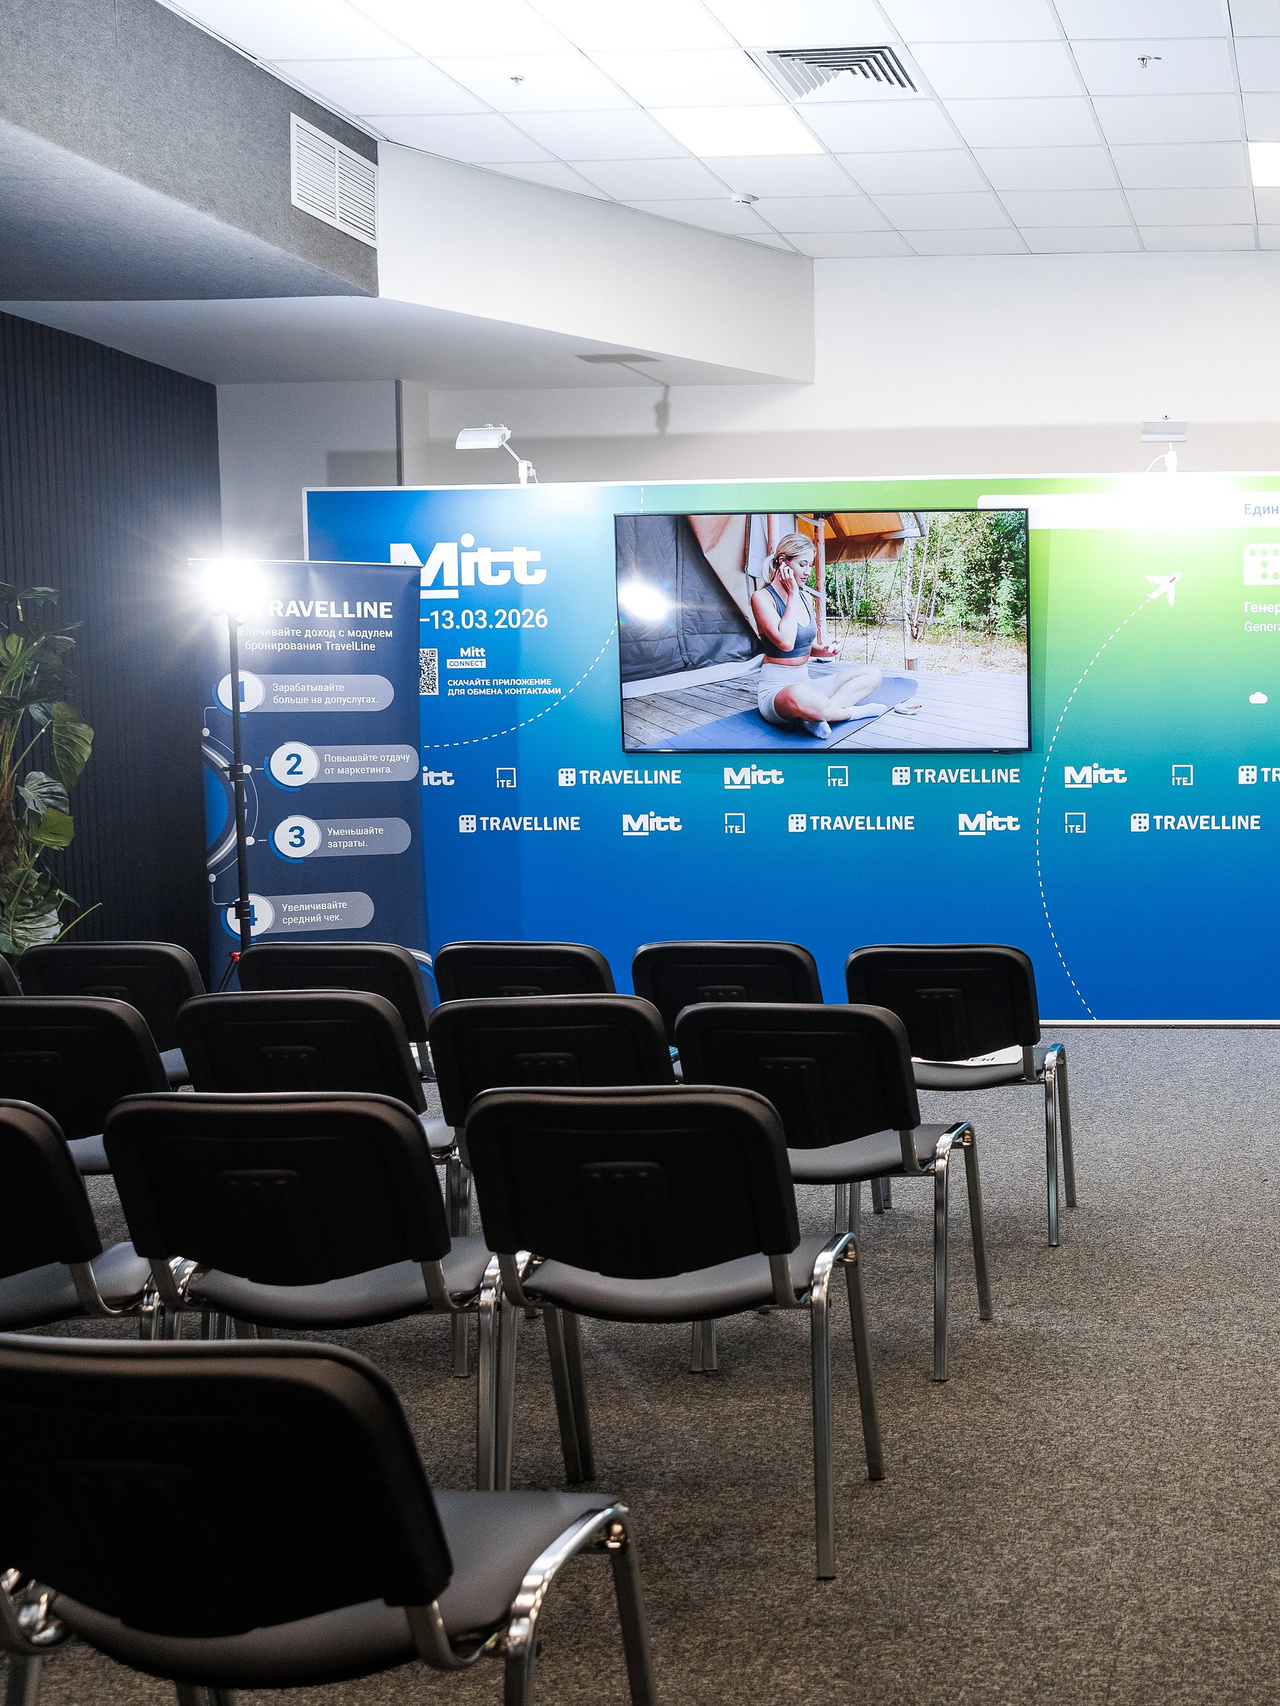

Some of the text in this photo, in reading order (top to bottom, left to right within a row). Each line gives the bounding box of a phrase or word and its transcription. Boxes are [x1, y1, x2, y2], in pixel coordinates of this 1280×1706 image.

[390, 533, 547, 587] Mitt
[239, 627, 393, 639] еличивайте доход с модулем
[245, 640, 376, 652] бронирования TravelLine
[460, 646, 486, 657] Mitt
[272, 682, 344, 693] Зарабатывайте
[447, 678, 552, 686] СКАЧАЙТЕ ПРИЛОЖЕНИЕ
[447, 688, 465, 696] ДЛЯ
[504, 687, 561, 695] КОНТАКТАМИ
[273, 695, 310, 704] больше
[324, 696, 379, 706] допуслугах.
[285, 753, 303, 775] 2
[324, 753, 410, 763] Повышайте отдачу
[337, 766, 393, 776] маркетинга.
[423, 766, 454, 785] itt
[580, 770, 681, 784] TRAVELLINE
[724, 764, 784, 785] Mitt
[914, 769, 1019, 783] TRAVELLINE
[1065, 763, 1127, 784] Mitt
[480, 817, 580, 830] TRAVELLINE
[623, 811, 682, 832] Mitt
[810, 816, 914, 830] TRAVELLINE
[959, 811, 1020, 832] Mitt
[1153, 815, 1260, 829] TRAVELLINE
[288, 826, 305, 847] 3
[327, 826, 384, 836] Уменьшайте
[327, 840, 368, 849] затраты.
[282, 901, 348, 912] Увеличивайте
[282, 914, 343, 925] средний чек.
